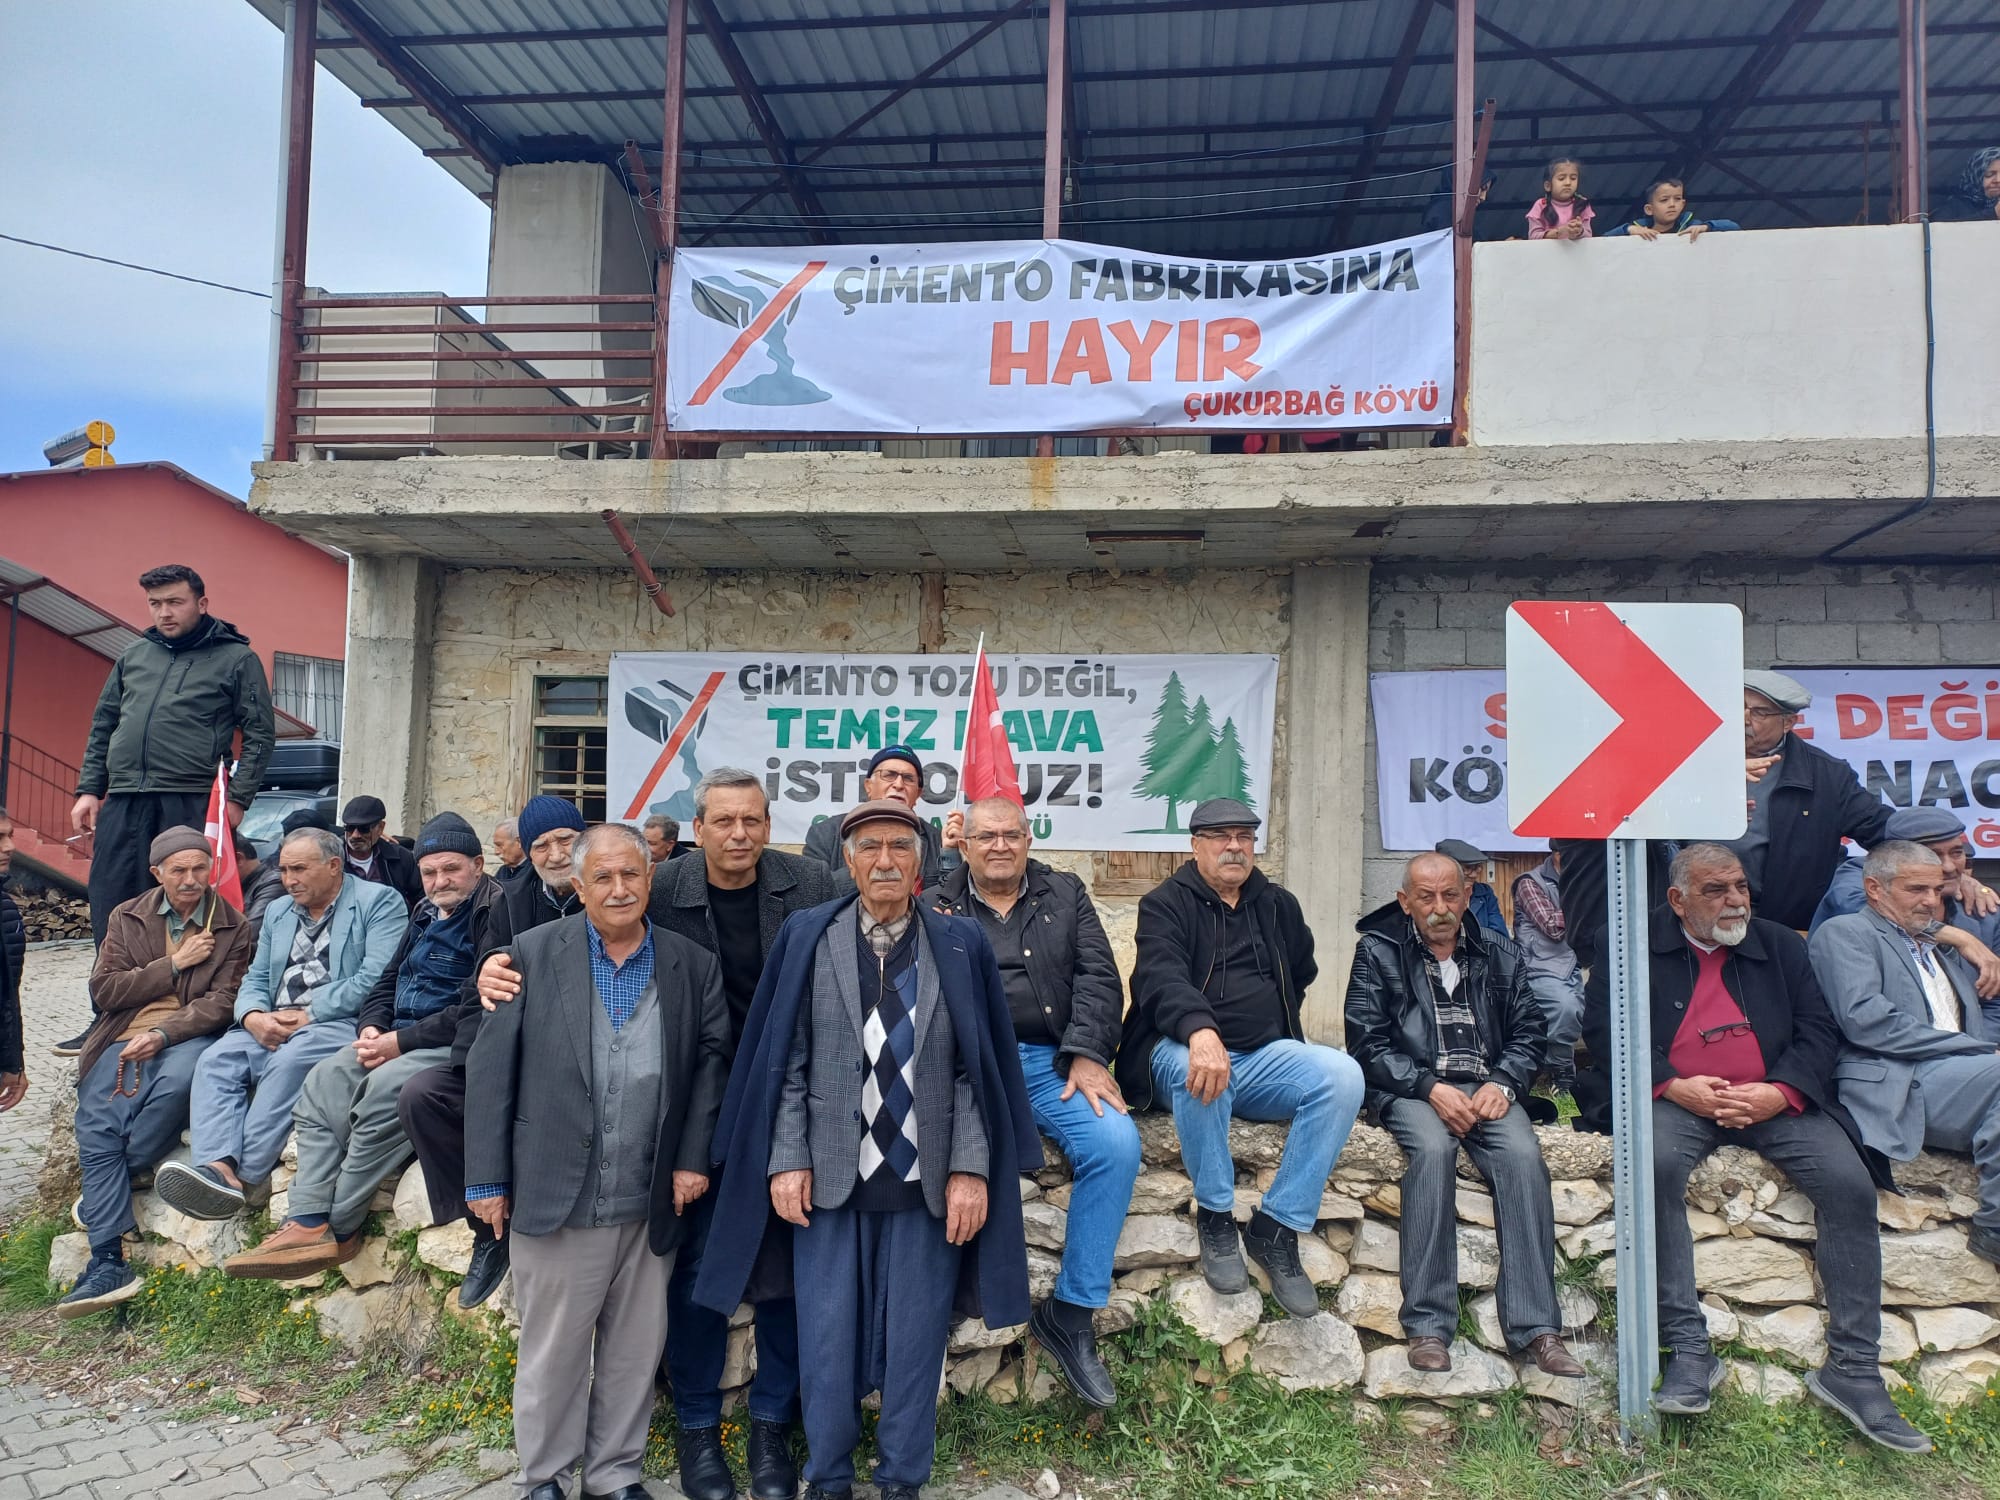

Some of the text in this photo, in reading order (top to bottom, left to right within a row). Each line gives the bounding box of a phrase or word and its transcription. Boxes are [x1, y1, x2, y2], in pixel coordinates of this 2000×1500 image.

[833, 247, 1420, 316] ÇİMENTO FABRİKASINA
[989, 317, 1263, 386] HAYIR
[1183, 380, 1438, 422] ÇUKURBAĞ KÖYÜ
[767, 705, 938, 751] TEMİZ
